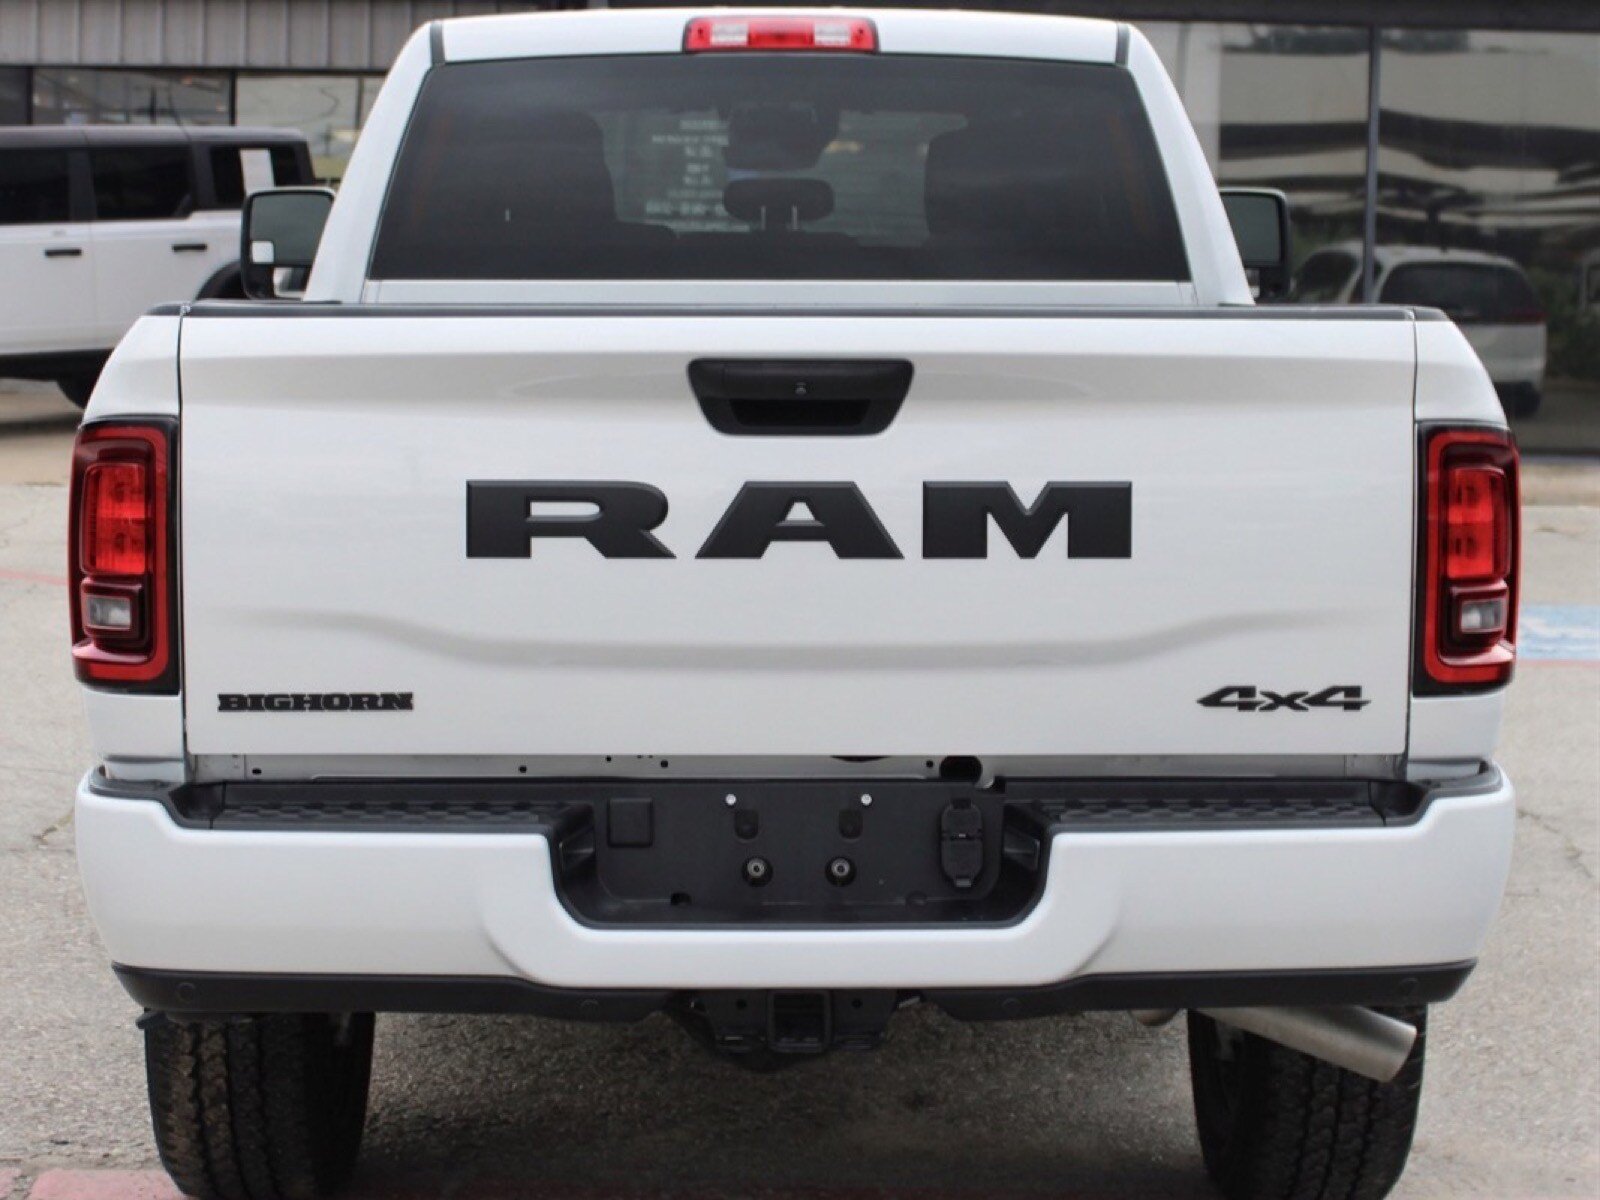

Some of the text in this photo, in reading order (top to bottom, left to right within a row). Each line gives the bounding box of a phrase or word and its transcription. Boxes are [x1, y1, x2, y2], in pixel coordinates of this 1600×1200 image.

[466, 480, 1133, 559] RAM
[218, 693, 414, 711] BIGHORN
[1197, 685, 1372, 712] 4x4
